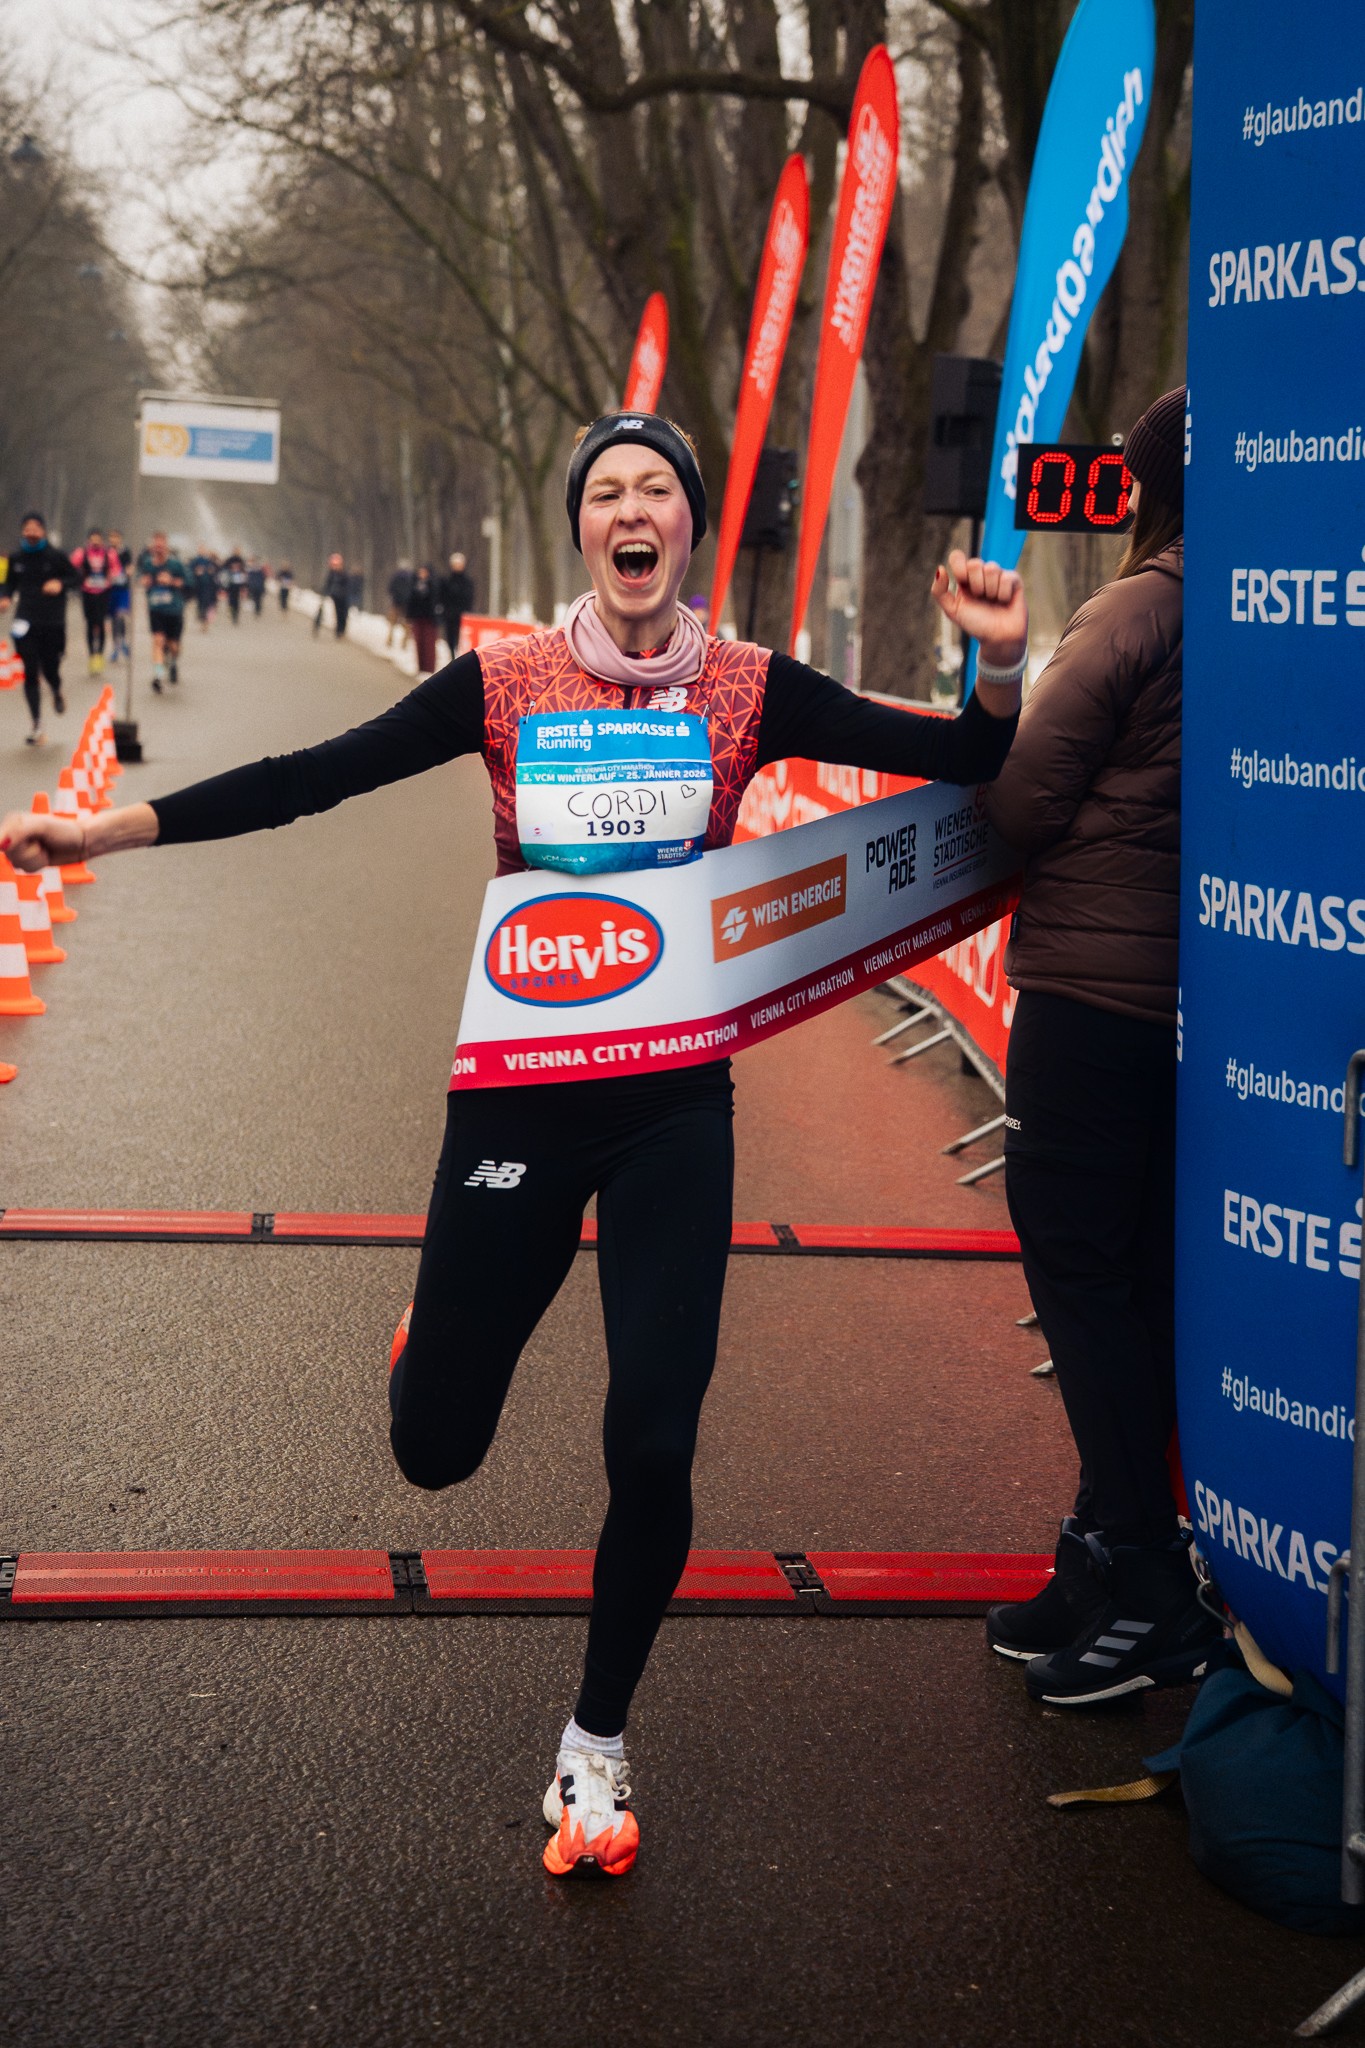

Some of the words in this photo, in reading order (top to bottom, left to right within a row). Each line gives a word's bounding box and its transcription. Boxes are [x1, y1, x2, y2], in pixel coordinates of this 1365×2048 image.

[1242, 87, 1365, 147] #glauband
[1234, 425, 1365, 473] #glaubandi
[1231, 568, 1338, 626] ERSTE
[537, 724, 578, 738] ERSTE
[597, 722, 675, 737] SPARKASSE
[537, 737, 591, 751] Running
[535, 773, 555, 782] VCM
[557, 772, 616, 782] WINTERLAUF
[626, 772, 640, 780] 25.
[643, 769, 681, 779] JÄNNER
[683, 769, 706, 778] 2026
[567, 788, 667, 819] CORDI
[935, 805, 973, 841] WIENER
[587, 820, 646, 837] 1903
[866, 823, 917, 873] POWER
[934, 823, 989, 868] STÄDTISCHE
[889, 854, 917, 894] ADE
[752, 896, 788, 928] WIEN
[791, 876, 841, 914] ENERGIE
[499, 920, 650, 980] Hervis
[503, 1049, 588, 1071] VIENNA
[593, 1042, 643, 1064] CITY
[648, 1022, 738, 1057] MARATHON
[750, 1001, 786, 1029] VIENNA
[787, 989, 807, 1013] CITY
[808, 968, 855, 1002] MARATHON
[863, 948, 894, 975] VIENNA
[895, 938, 911, 960] CITY
[912, 918, 953, 950] MARATHON
[960, 901, 986, 926] VIENNA
[510, 973, 580, 989] SPORTS
[1226, 1057, 1365, 1117] #glauband
[1223, 1188, 1331, 1272] ERSTE
[1194, 1479, 1351, 1600] SPARKAS
